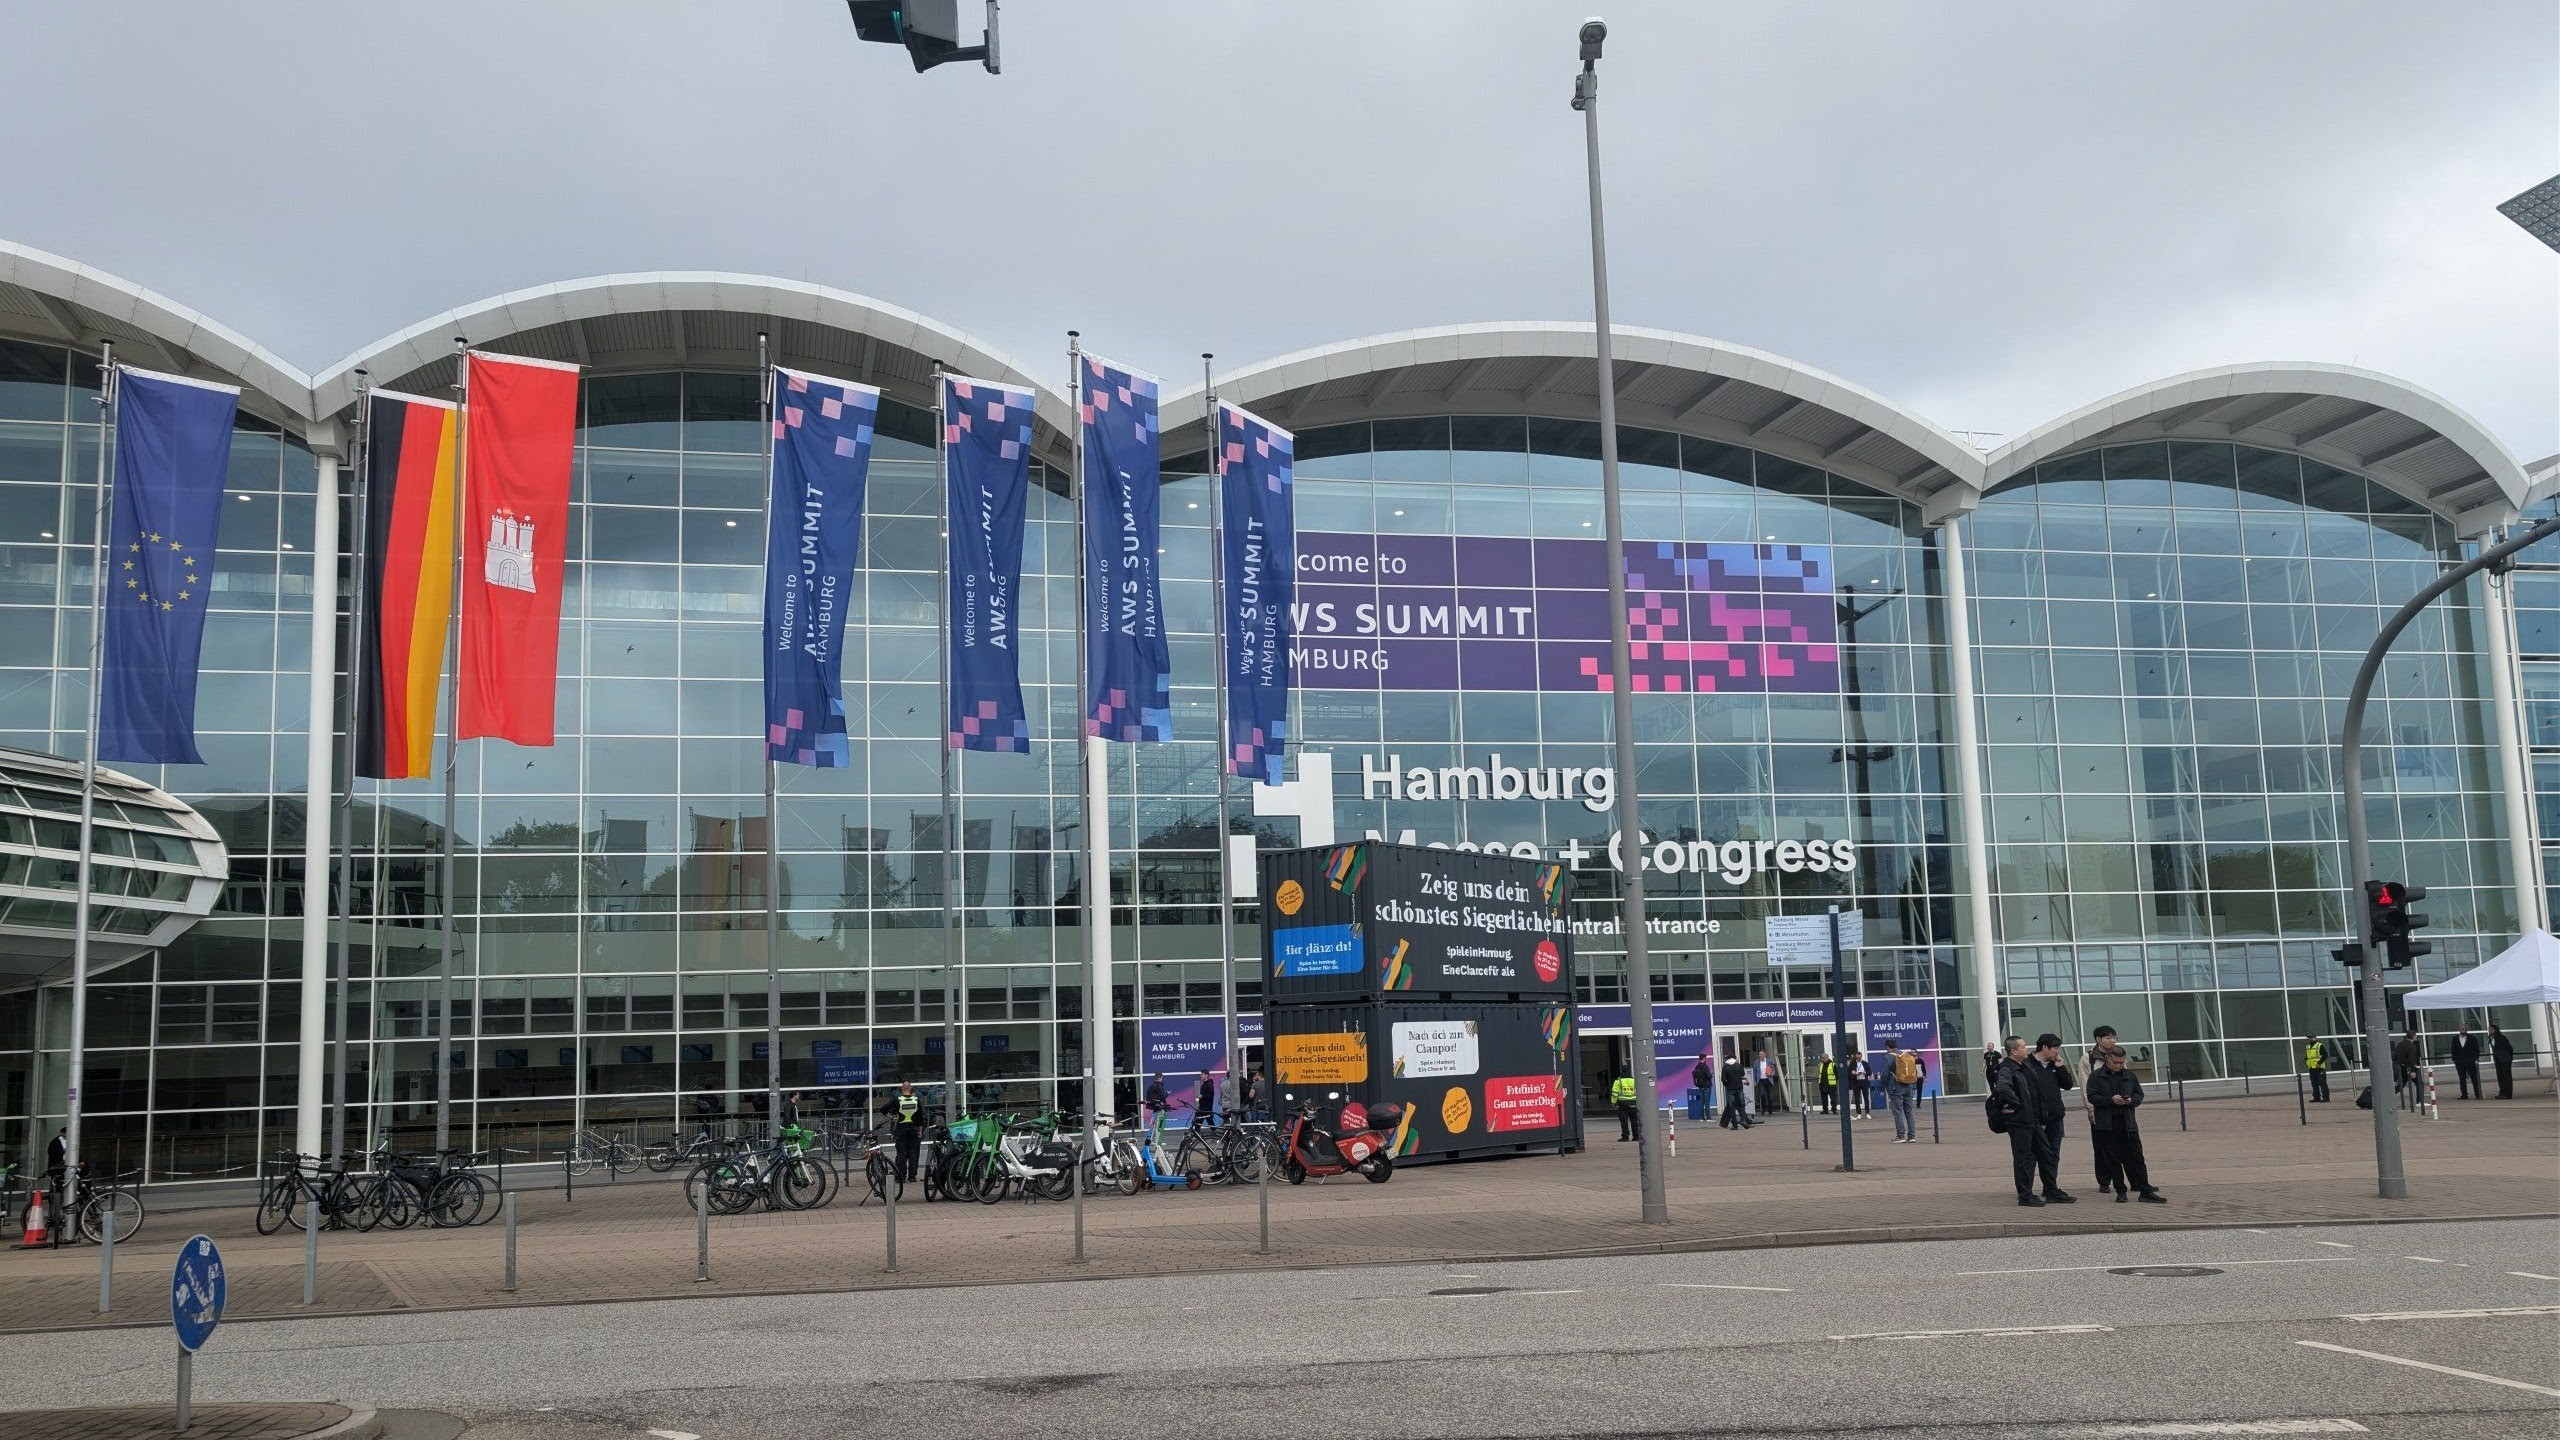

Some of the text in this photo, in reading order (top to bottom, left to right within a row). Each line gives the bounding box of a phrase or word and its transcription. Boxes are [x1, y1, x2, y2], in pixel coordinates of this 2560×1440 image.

[1242, 516, 1263, 620] SUMMIT
[1297, 552, 1407, 574] come to
[964, 574, 976, 648] Welcome to
[1100, 558, 1109, 633] Welcome to
[1122, 580, 1138, 636] AWS
[778, 574, 797, 651] Welcome to
[816, 574, 836, 662] HAMBURG
[1289, 602, 1532, 636] WS SUMMIT
[1260, 604, 1277, 686] HAMBURG
[1288, 648, 1389, 670] MBURG
[1362, 753, 1616, 812] Hamburg
[1608, 828, 1857, 886] Congress
[1420, 872, 1530, 902] Zeig uns dein
[1376, 899, 1459, 926] schönstes
[1572, 916, 1720, 935] ntral ntrance
[1239, 1022, 1264, 1033] Speak
[1756, 1008, 1824, 1018] General Attendee
[1894, 1022, 1930, 1030] SUMMIT
[1152, 1042, 1218, 1052] AWS SUMMIT
[1652, 1028, 1704, 1037] WS SUMMIT
